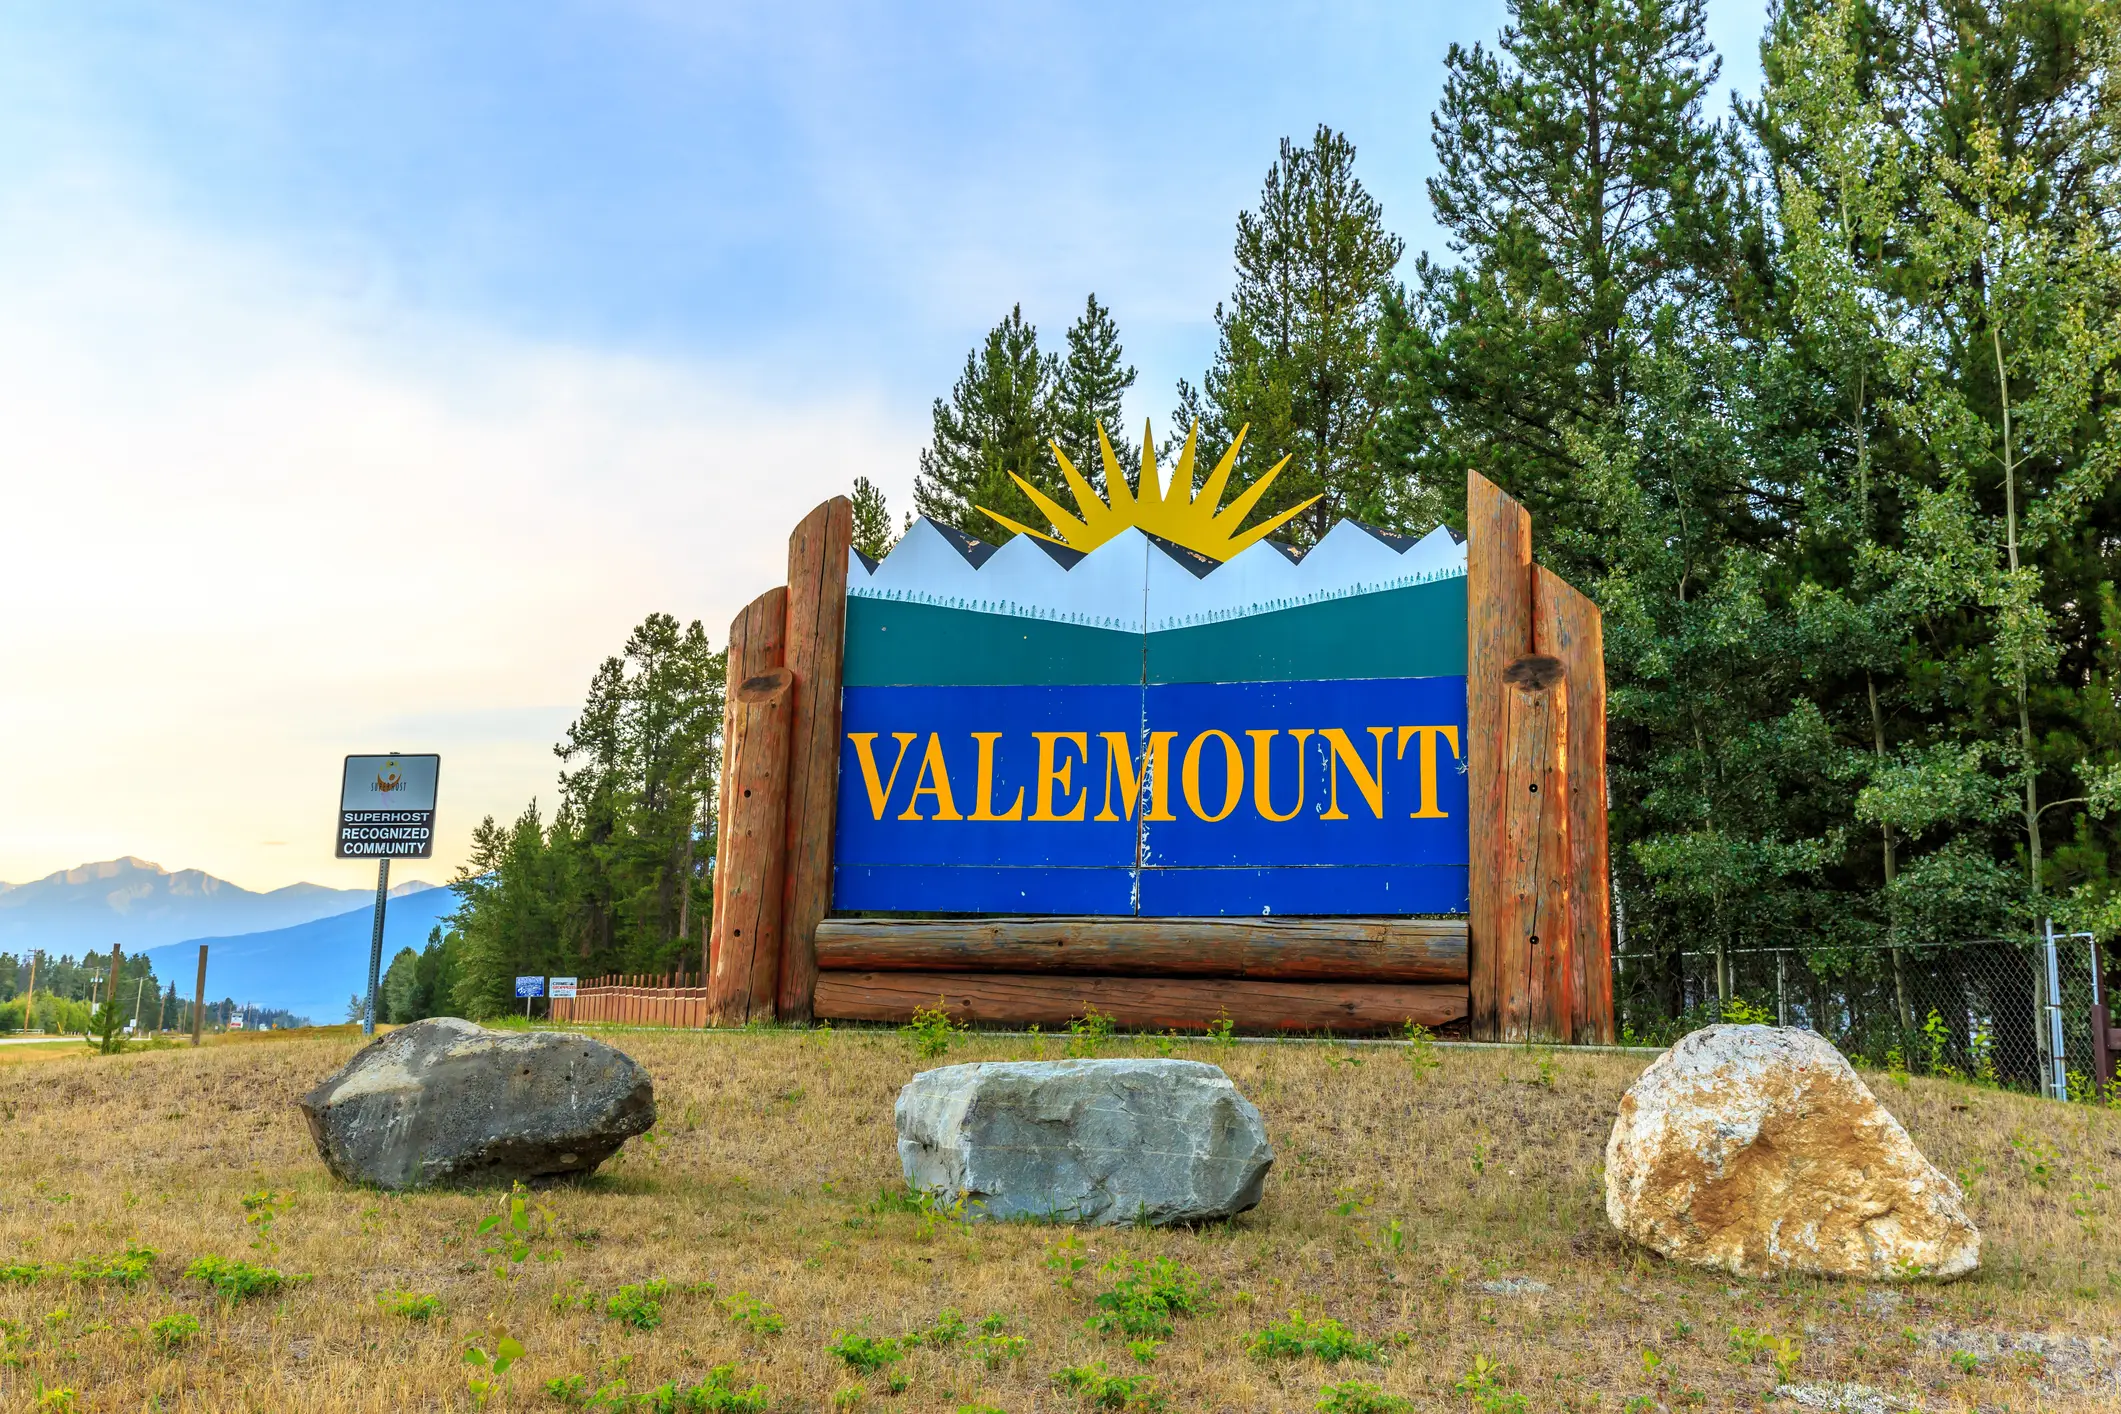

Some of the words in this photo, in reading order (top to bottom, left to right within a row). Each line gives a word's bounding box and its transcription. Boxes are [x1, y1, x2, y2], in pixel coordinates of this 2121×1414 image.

[847, 725, 1461, 823] VALEMOUNT
[344, 812, 430, 822] SUPERHOST
[342, 828, 430, 840] RECOGNIZED
[343, 842, 426, 854] COMMUNITY
